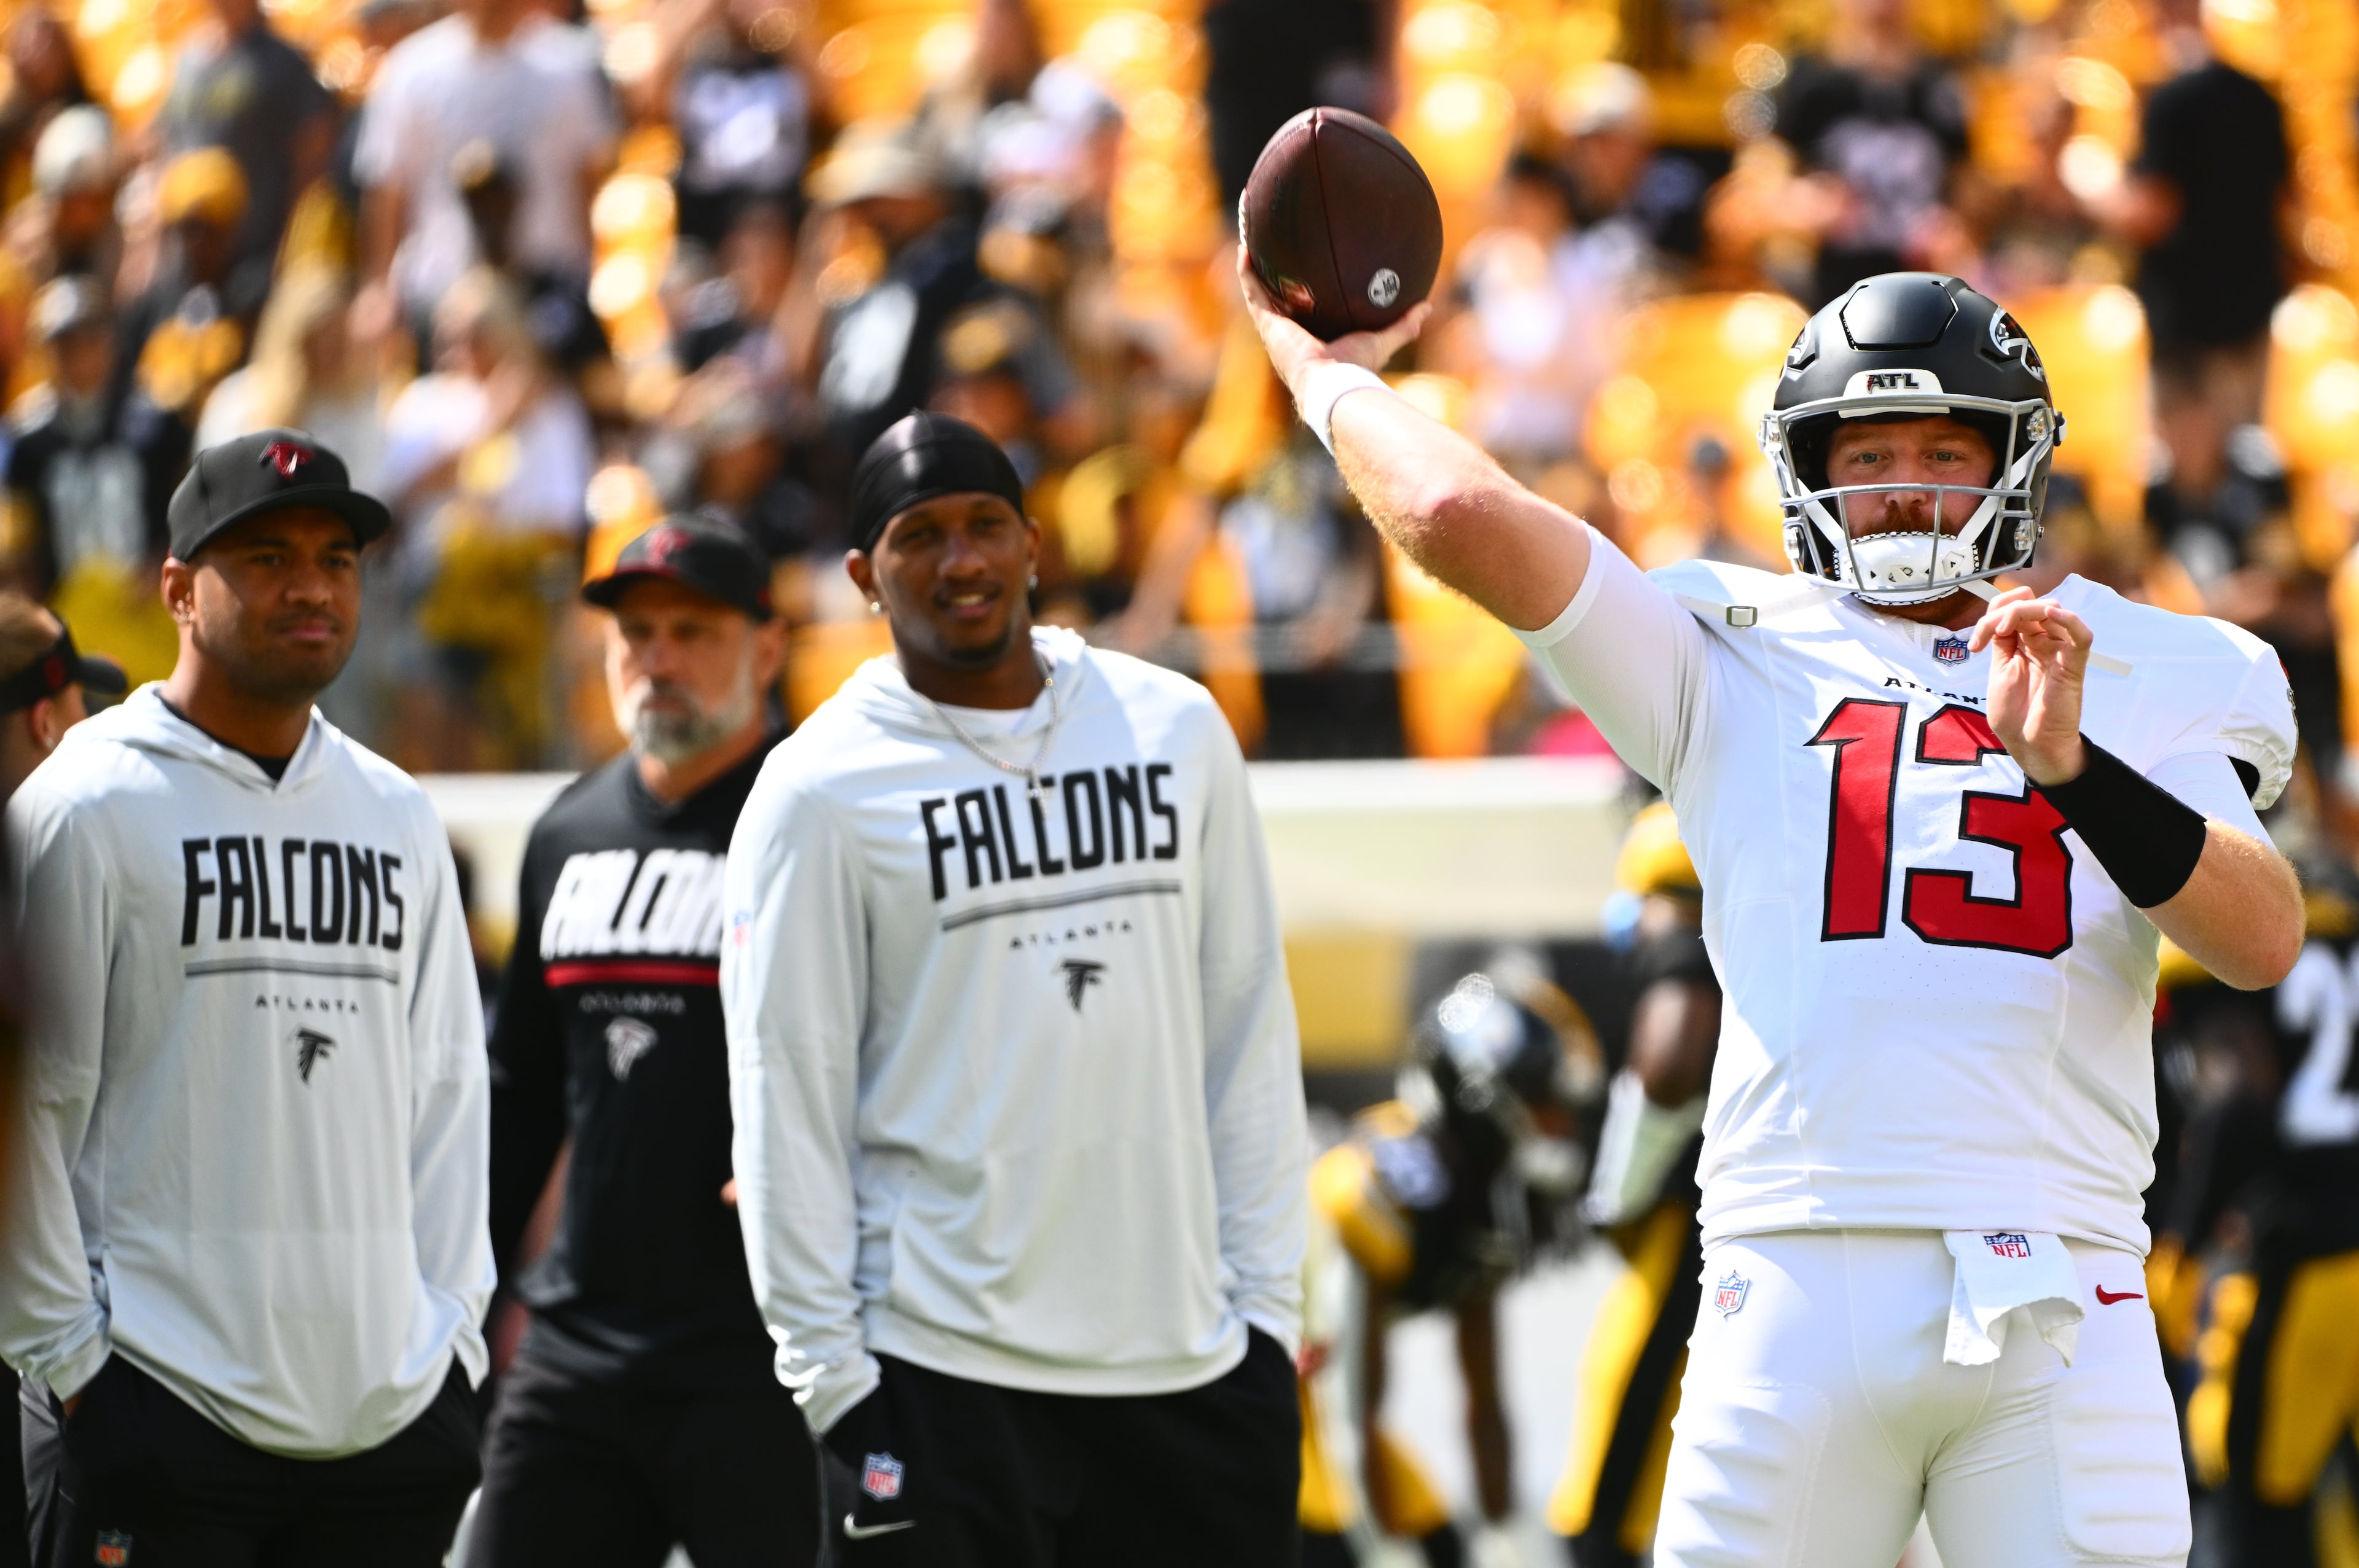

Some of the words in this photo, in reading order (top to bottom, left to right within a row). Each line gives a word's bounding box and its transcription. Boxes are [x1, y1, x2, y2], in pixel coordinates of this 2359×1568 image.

[1866, 372, 1920, 394] ATL
[1938, 648, 1963, 659] NFL
[921, 762, 1178, 902] FALCONS
[1803, 697, 2074, 960] 13
[182, 835, 404, 951] FALCONS
[539, 847, 727, 960] FALCON
[1009, 920, 1133, 950] ATLANTA
[255, 994, 359, 1013] ATLANTA
[2273, 938, 2359, 1146] 2
[1991, 1243, 2027, 1258] NFL
[1717, 1290, 1737, 1308] NFL
